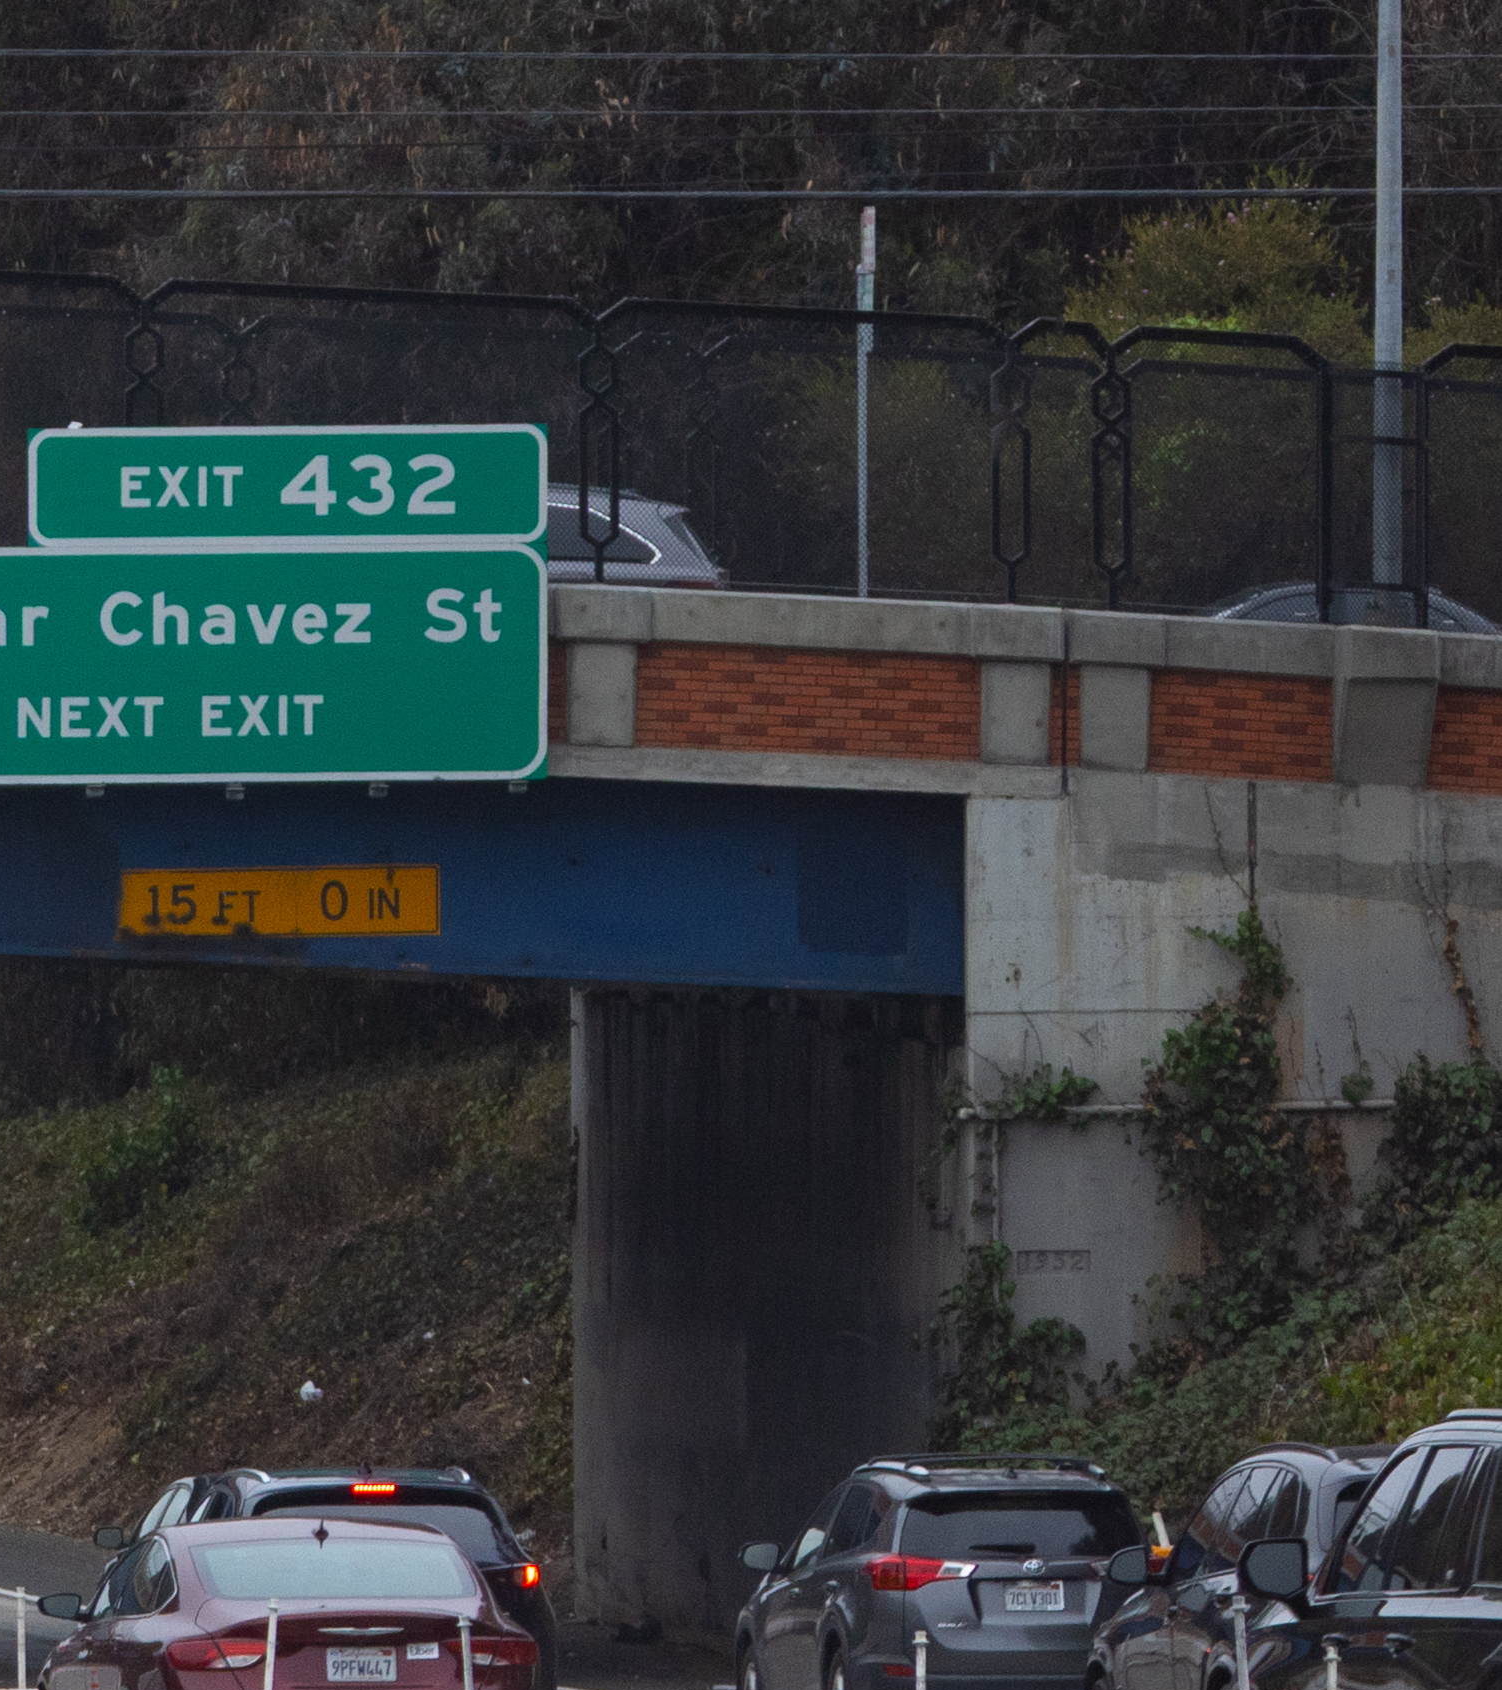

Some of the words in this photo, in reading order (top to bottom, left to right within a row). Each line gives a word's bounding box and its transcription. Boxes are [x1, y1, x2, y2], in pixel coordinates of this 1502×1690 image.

[120, 465, 244, 508] EXIT
[280, 453, 457, 516] 432
[99, 590, 372, 649] Chavez
[424, 587, 503, 644] St
[17, 695, 164, 739] NEXT
[200, 694, 325, 738] EXIT
[144, 884, 198, 925] 15
[213, 890, 262, 925] FT
[368, 887, 401, 919] IN
[331, 1659, 392, 1677] 9PFW447
